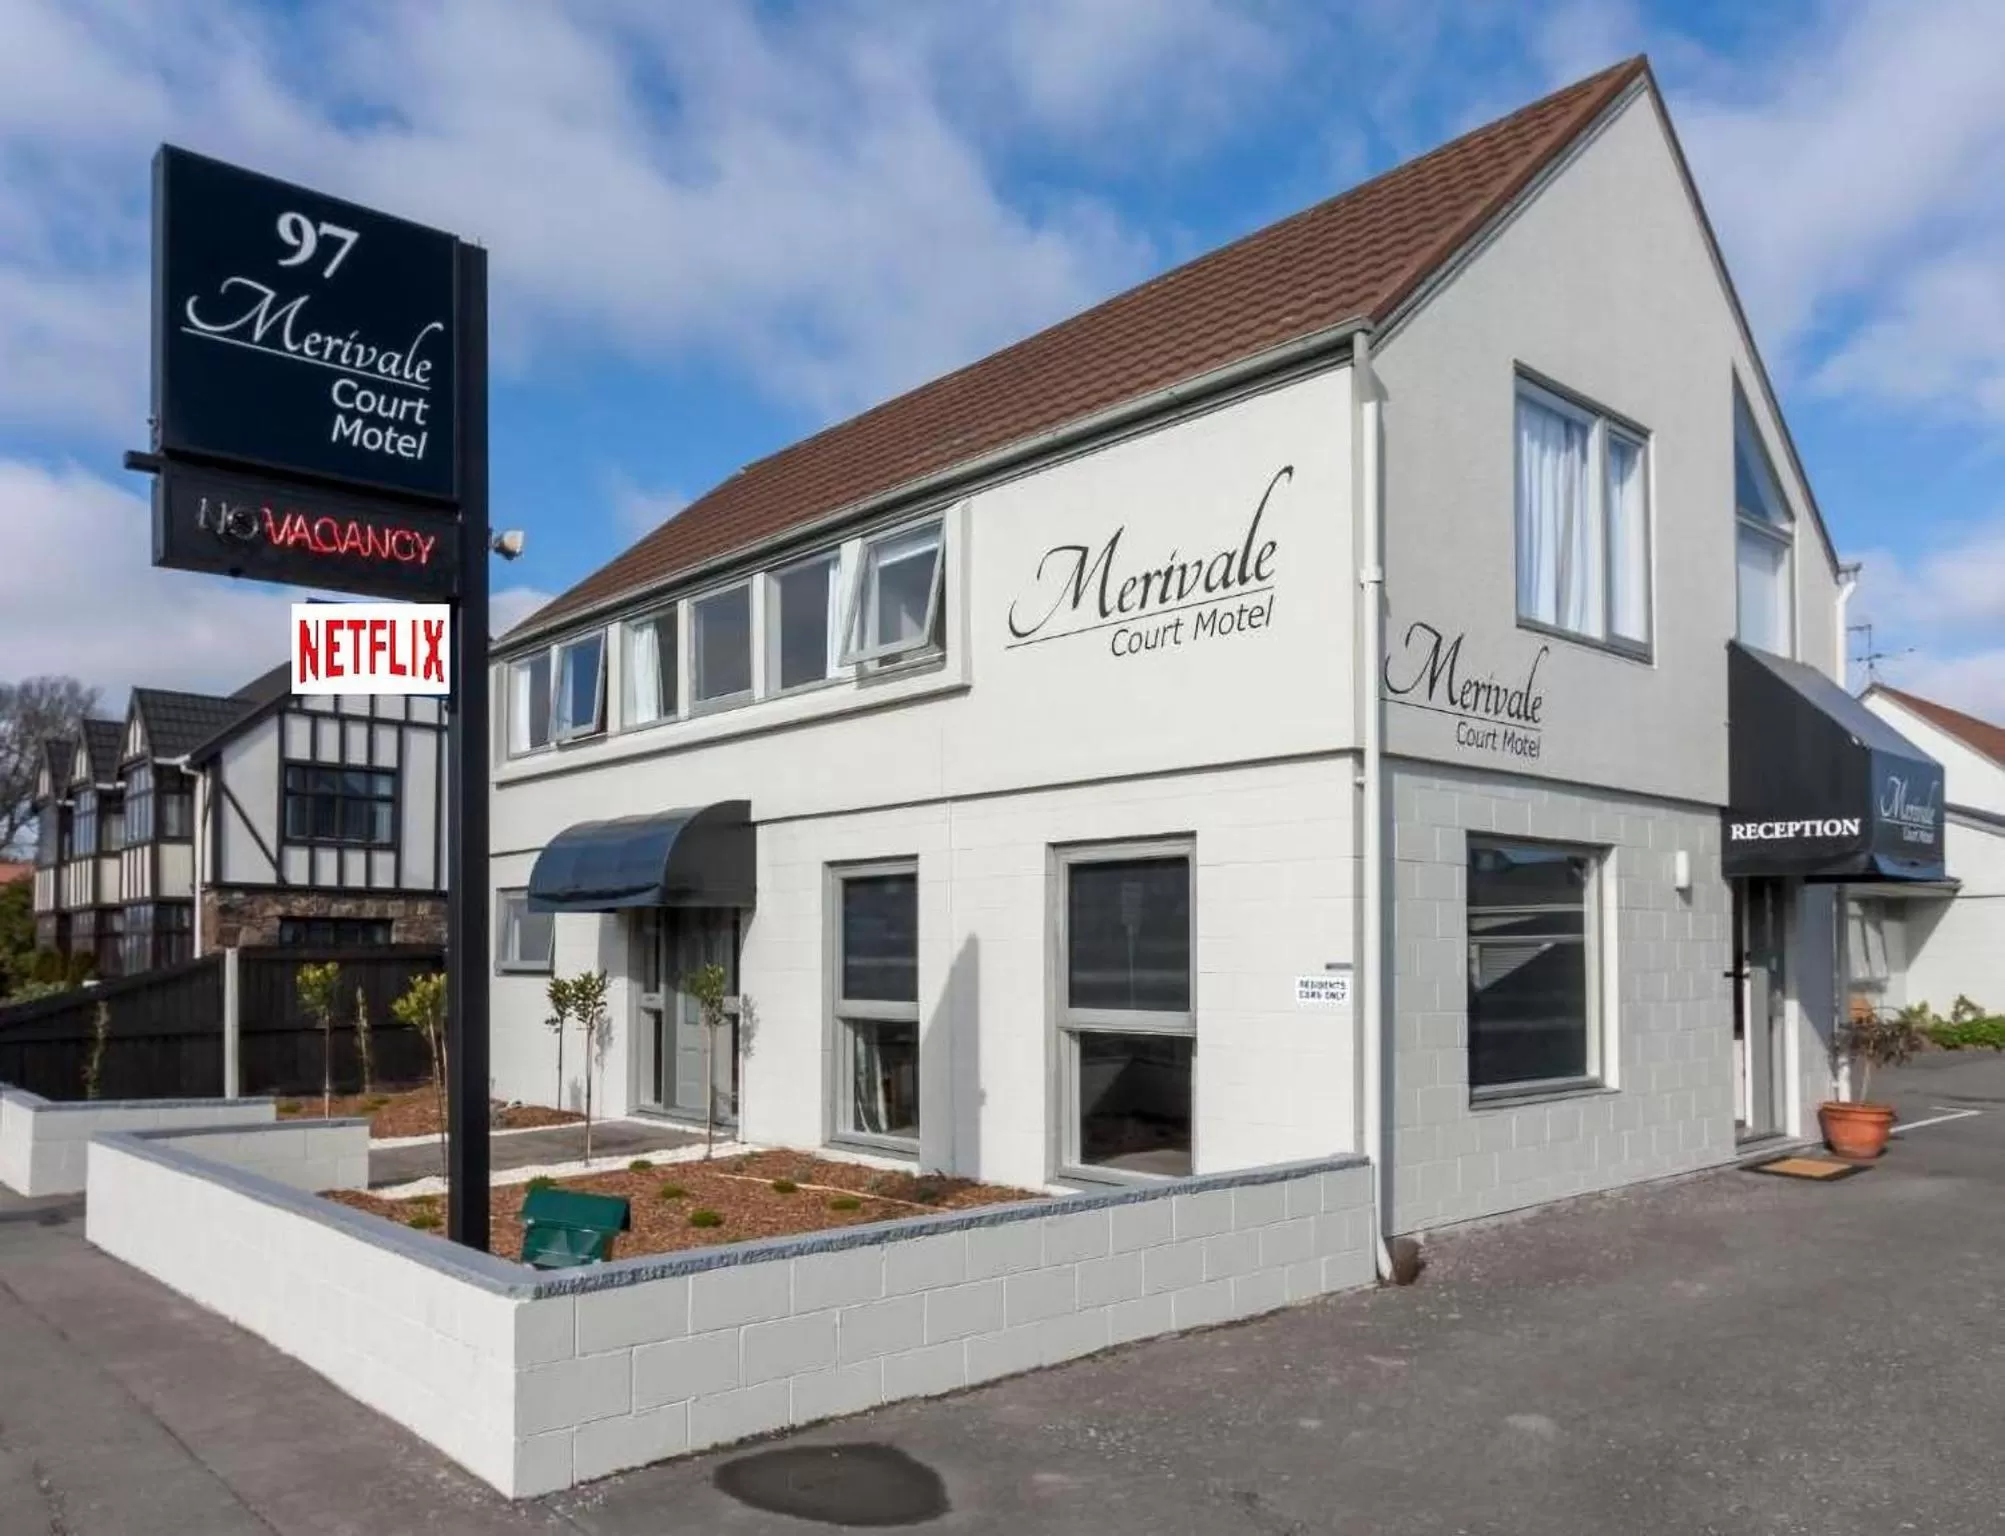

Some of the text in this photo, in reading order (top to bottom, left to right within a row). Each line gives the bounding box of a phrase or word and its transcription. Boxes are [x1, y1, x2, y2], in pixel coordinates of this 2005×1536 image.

[277, 212, 360, 278] 97
[186, 277, 444, 384] Merivale
[331, 379, 430, 426] Court
[331, 414, 428, 460] Motel
[261, 504, 435, 564] VACANCY
[1008, 465, 1294, 638] Merivale
[299, 619, 445, 684] NETFLIX
[1112, 595, 1274, 657] Court Motel
[1385, 622, 1549, 723] Merivale
[1457, 721, 1540, 758] Court Motel
[1731, 818, 1861, 840] RECEPTION
